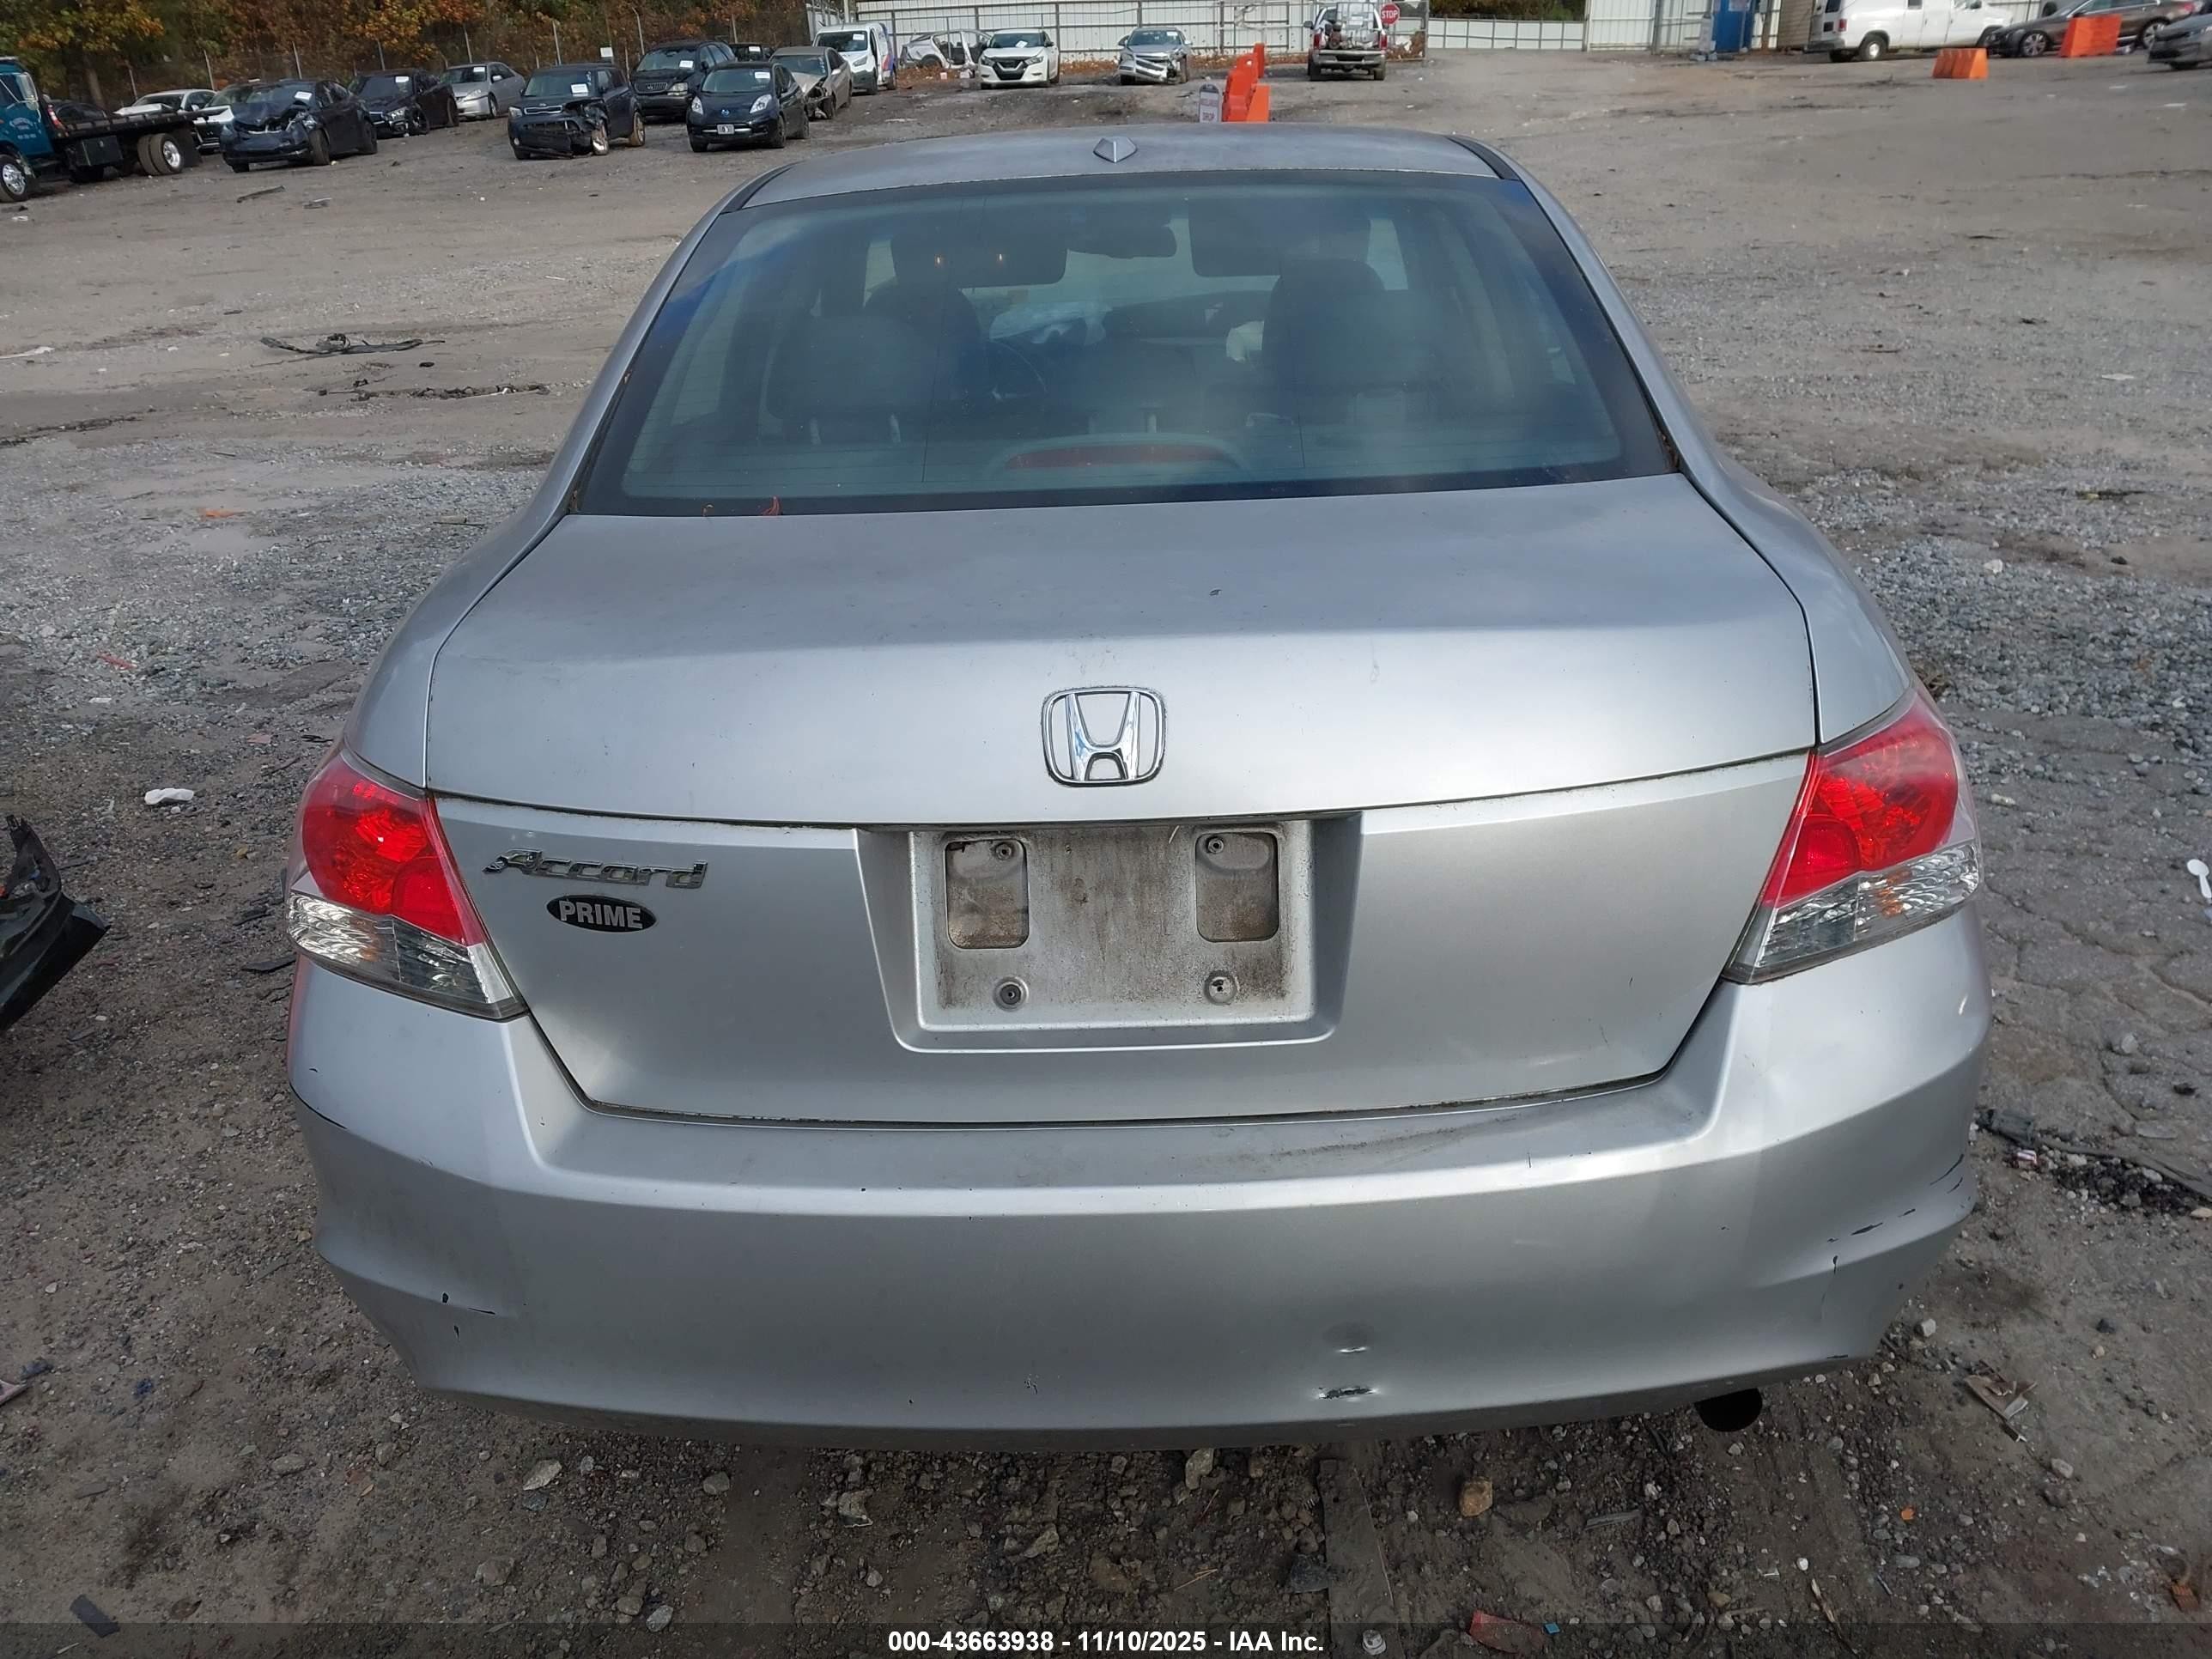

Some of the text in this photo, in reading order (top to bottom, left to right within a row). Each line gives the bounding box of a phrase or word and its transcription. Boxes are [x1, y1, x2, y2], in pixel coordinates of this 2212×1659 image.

[1382, 9, 1398, 18] STOP
[482, 848, 708, 889] Accord
[558, 899, 644, 929] PRIME
